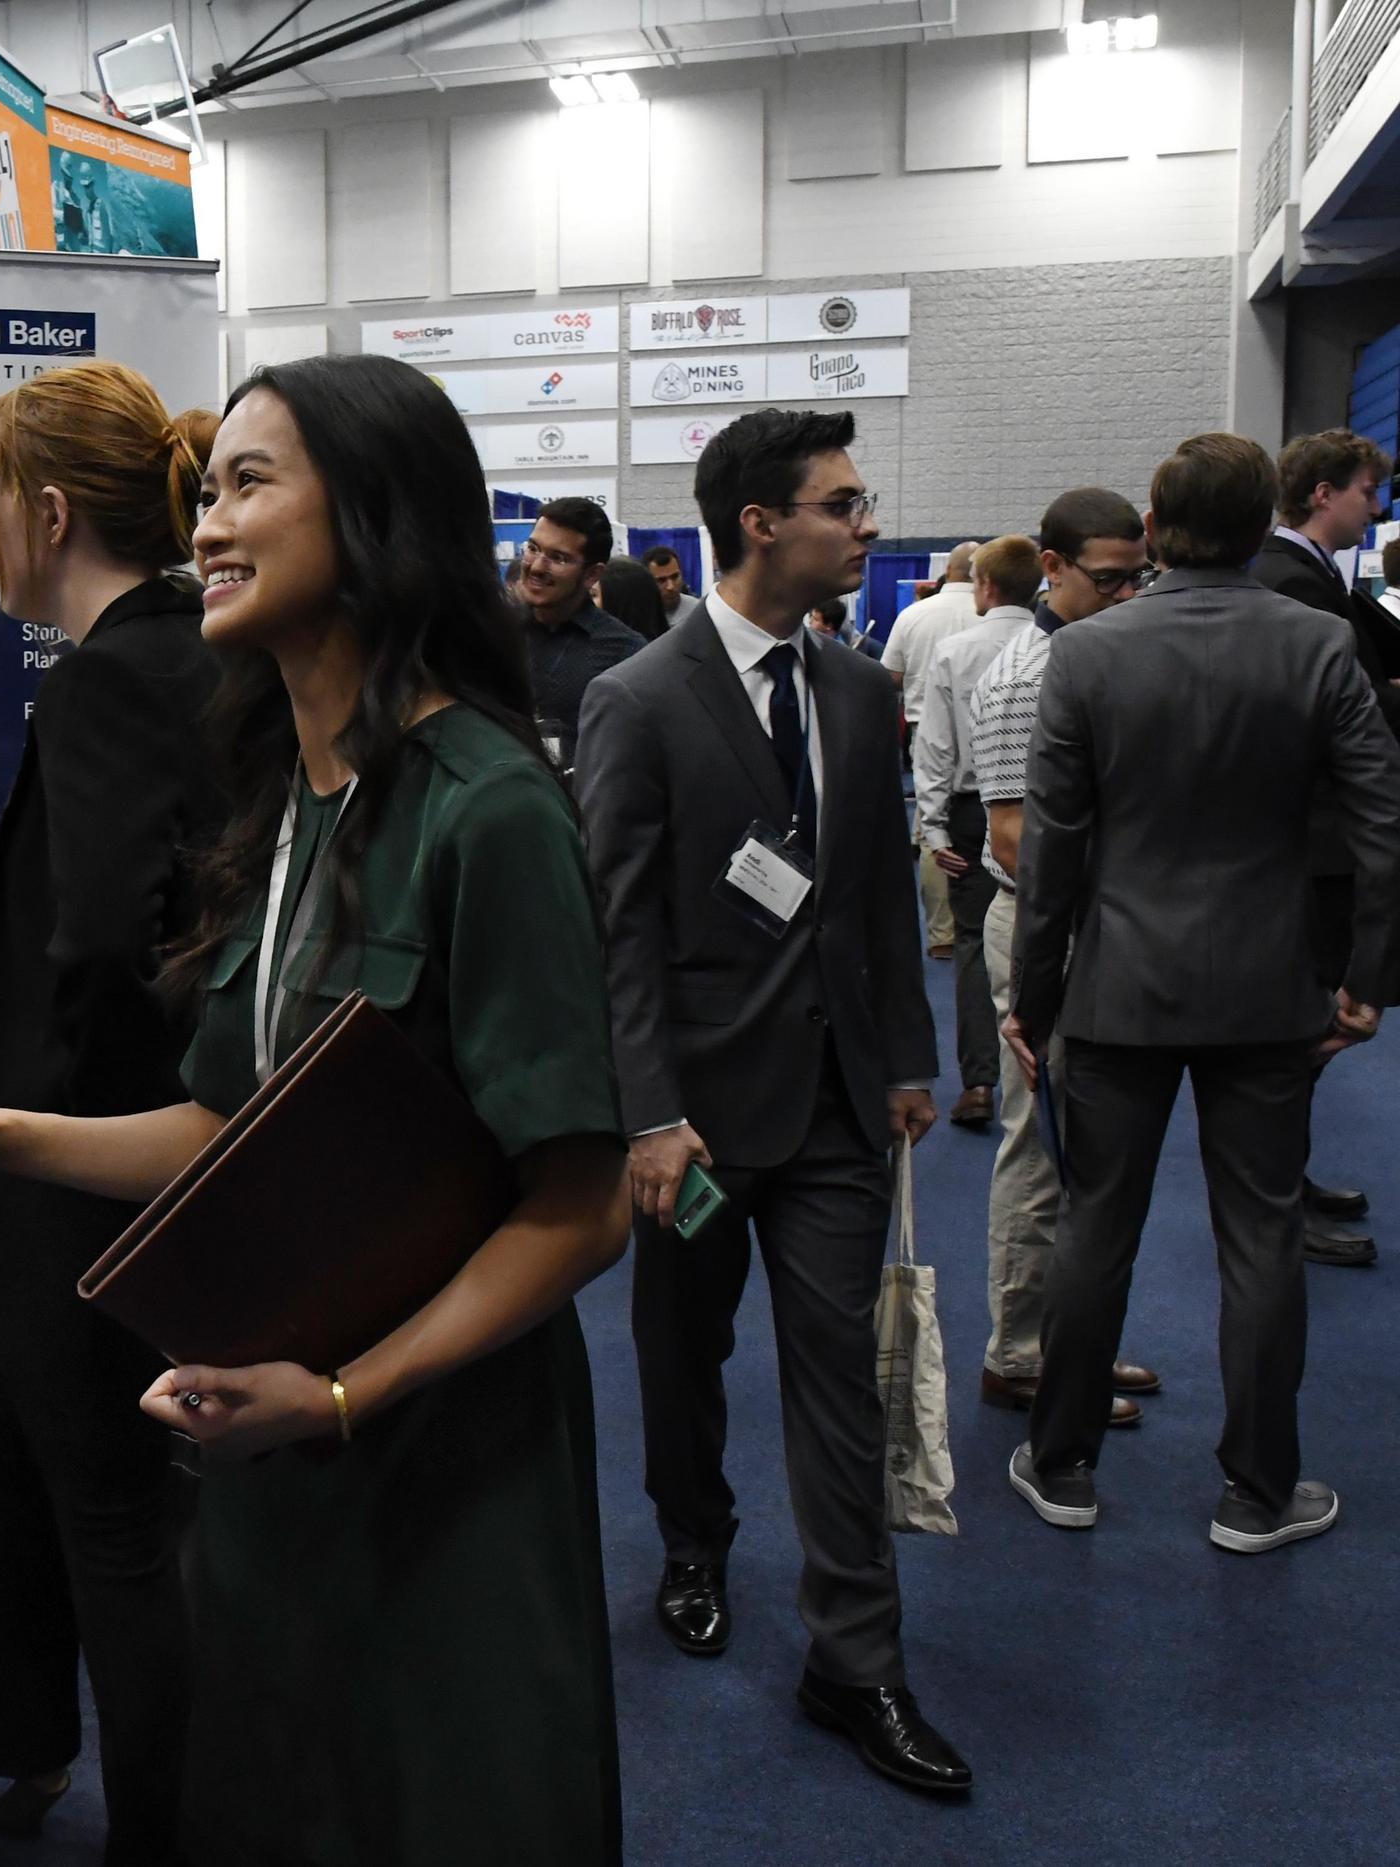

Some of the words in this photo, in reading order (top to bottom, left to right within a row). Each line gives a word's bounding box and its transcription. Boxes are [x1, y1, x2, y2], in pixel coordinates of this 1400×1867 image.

[651, 309, 694, 332] BUFFALO
[716, 308, 747, 334] ROSE
[8, 320, 87, 347] Baker
[393, 327, 454, 340] SportClips
[514, 329, 585, 346] canvas
[687, 364, 738, 379] MINES
[809, 353, 853, 381] Guapo
[693, 380, 744, 393] DINING
[834, 372, 865, 395] Taco
[24, 701, 34, 720] F
